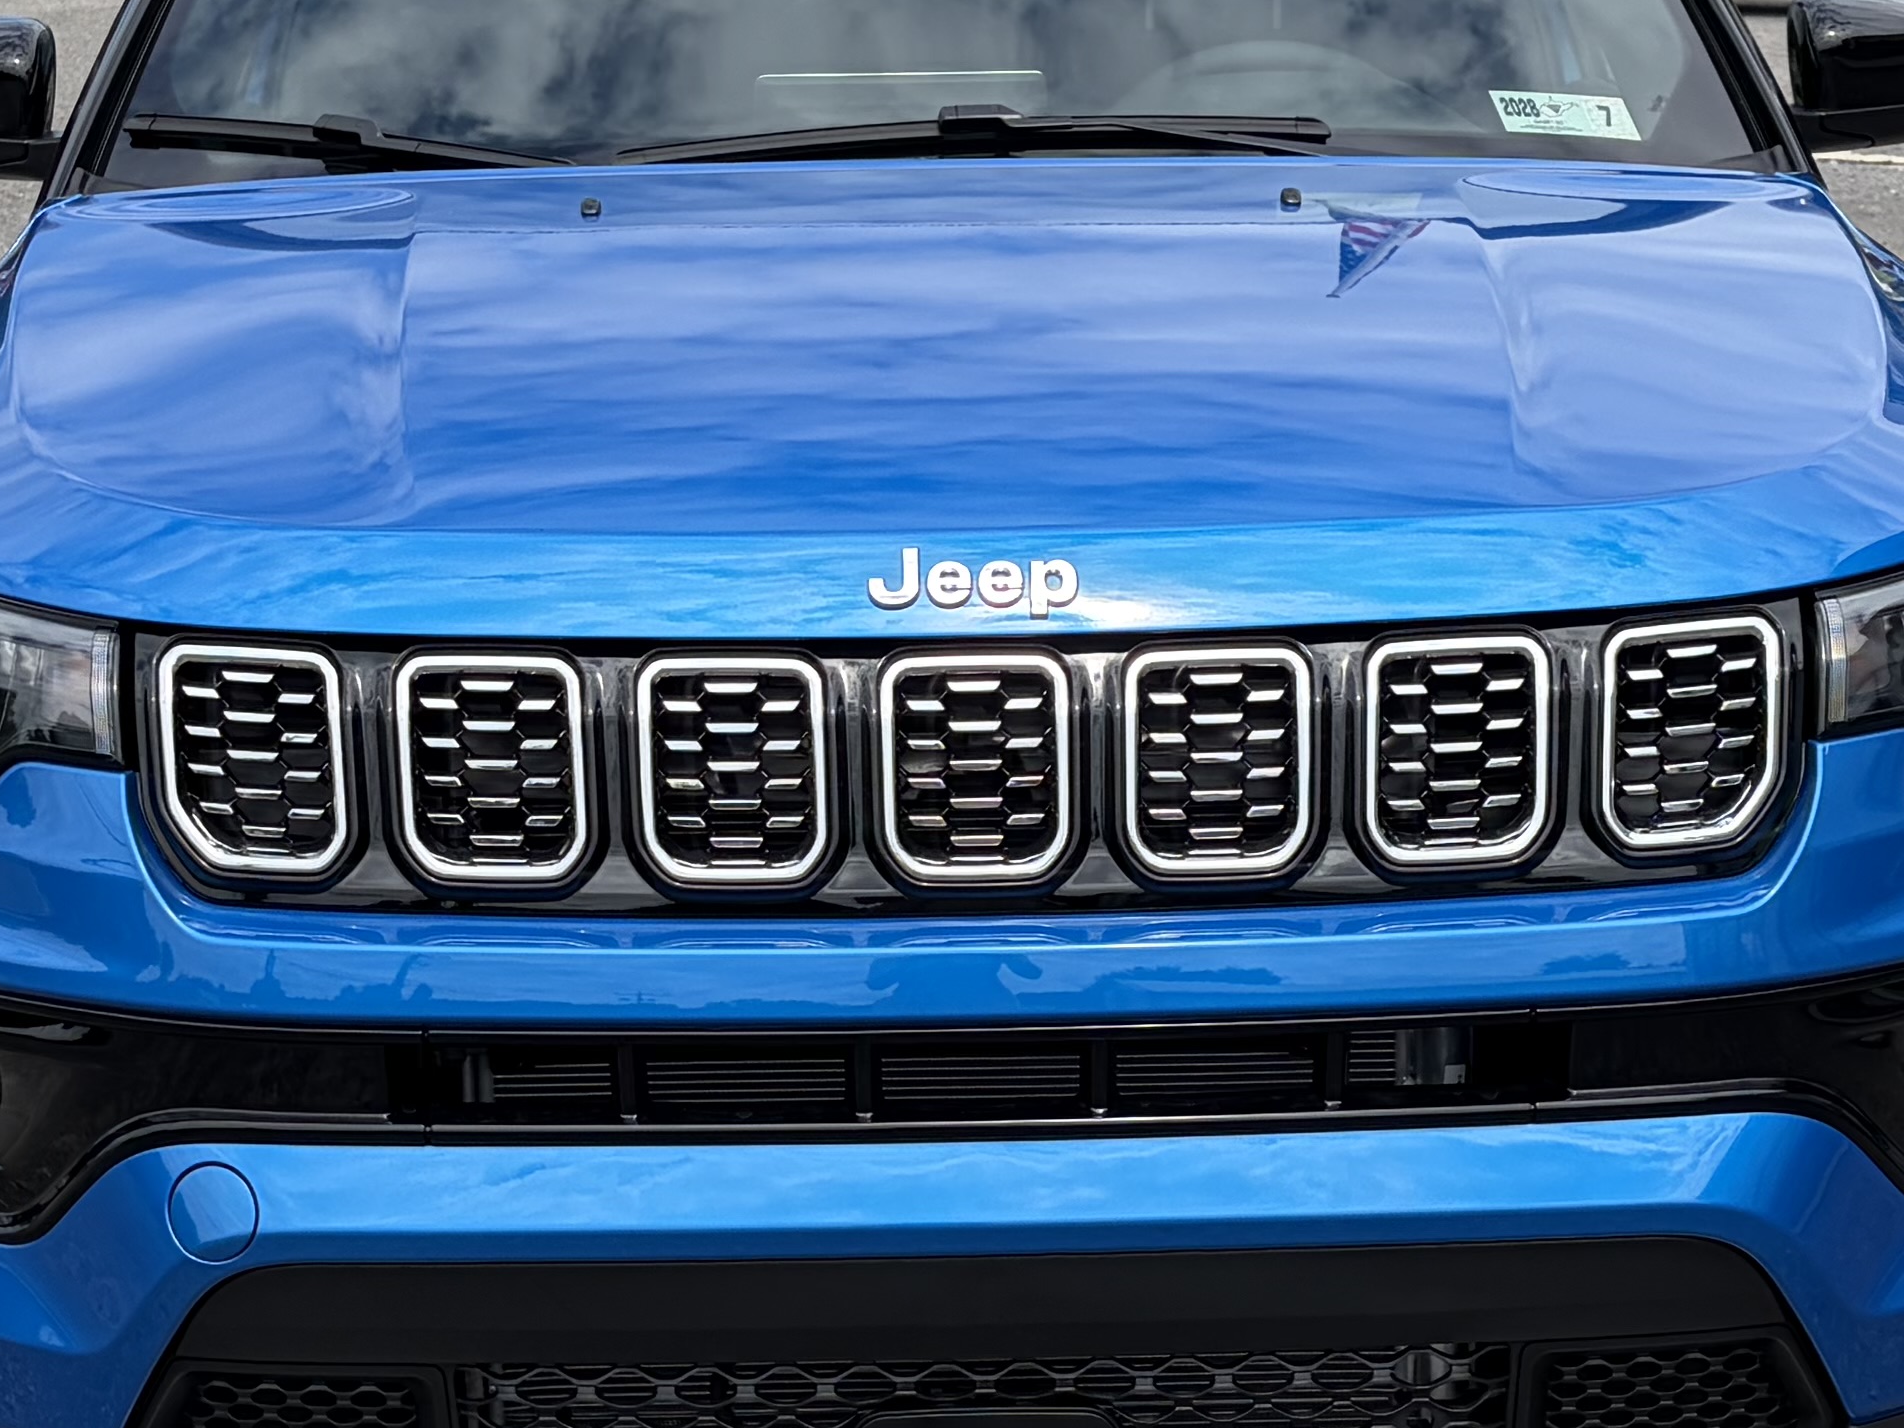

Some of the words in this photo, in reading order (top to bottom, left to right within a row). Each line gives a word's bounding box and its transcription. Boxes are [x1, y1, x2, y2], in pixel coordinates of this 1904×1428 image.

[1499, 97, 1541, 118] 2028
[1596, 105, 1612, 127] 7
[867, 547, 1080, 620] Jeep
